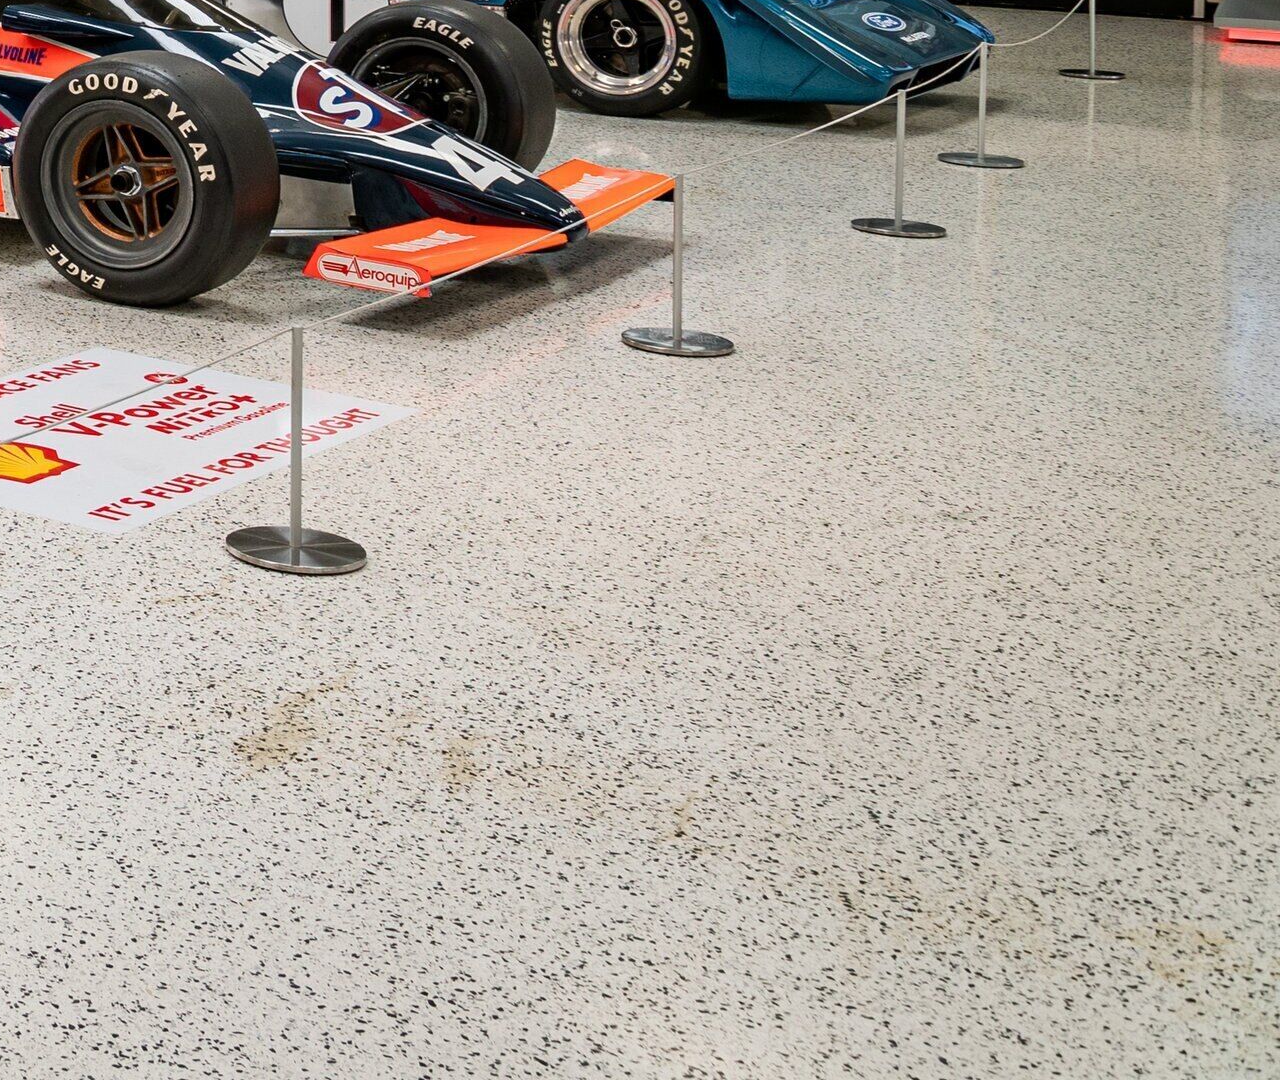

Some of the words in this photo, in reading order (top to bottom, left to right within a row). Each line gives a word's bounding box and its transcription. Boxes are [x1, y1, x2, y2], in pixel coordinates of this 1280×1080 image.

[412, 17, 474, 50] EAGLE
[542, 19, 558, 68] EAGLE
[658, 41, 696, 96] YEAR
[68, 73, 139, 96] GOOD
[166, 102, 216, 182] YEAR
[45, 243, 106, 290] EAGLE
[347, 255, 418, 292] Aeroquip
[27, 358, 101, 386] FANS
[14, 402, 87, 430] Shell
[50, 385, 222, 439] V-Power
[182, 416, 242, 442] Premium
[238, 401, 293, 428] Gasoline
[88, 494, 156, 522] IT'S
[147, 471, 220, 501] FUEL
[216, 447, 267, 476] FOR
